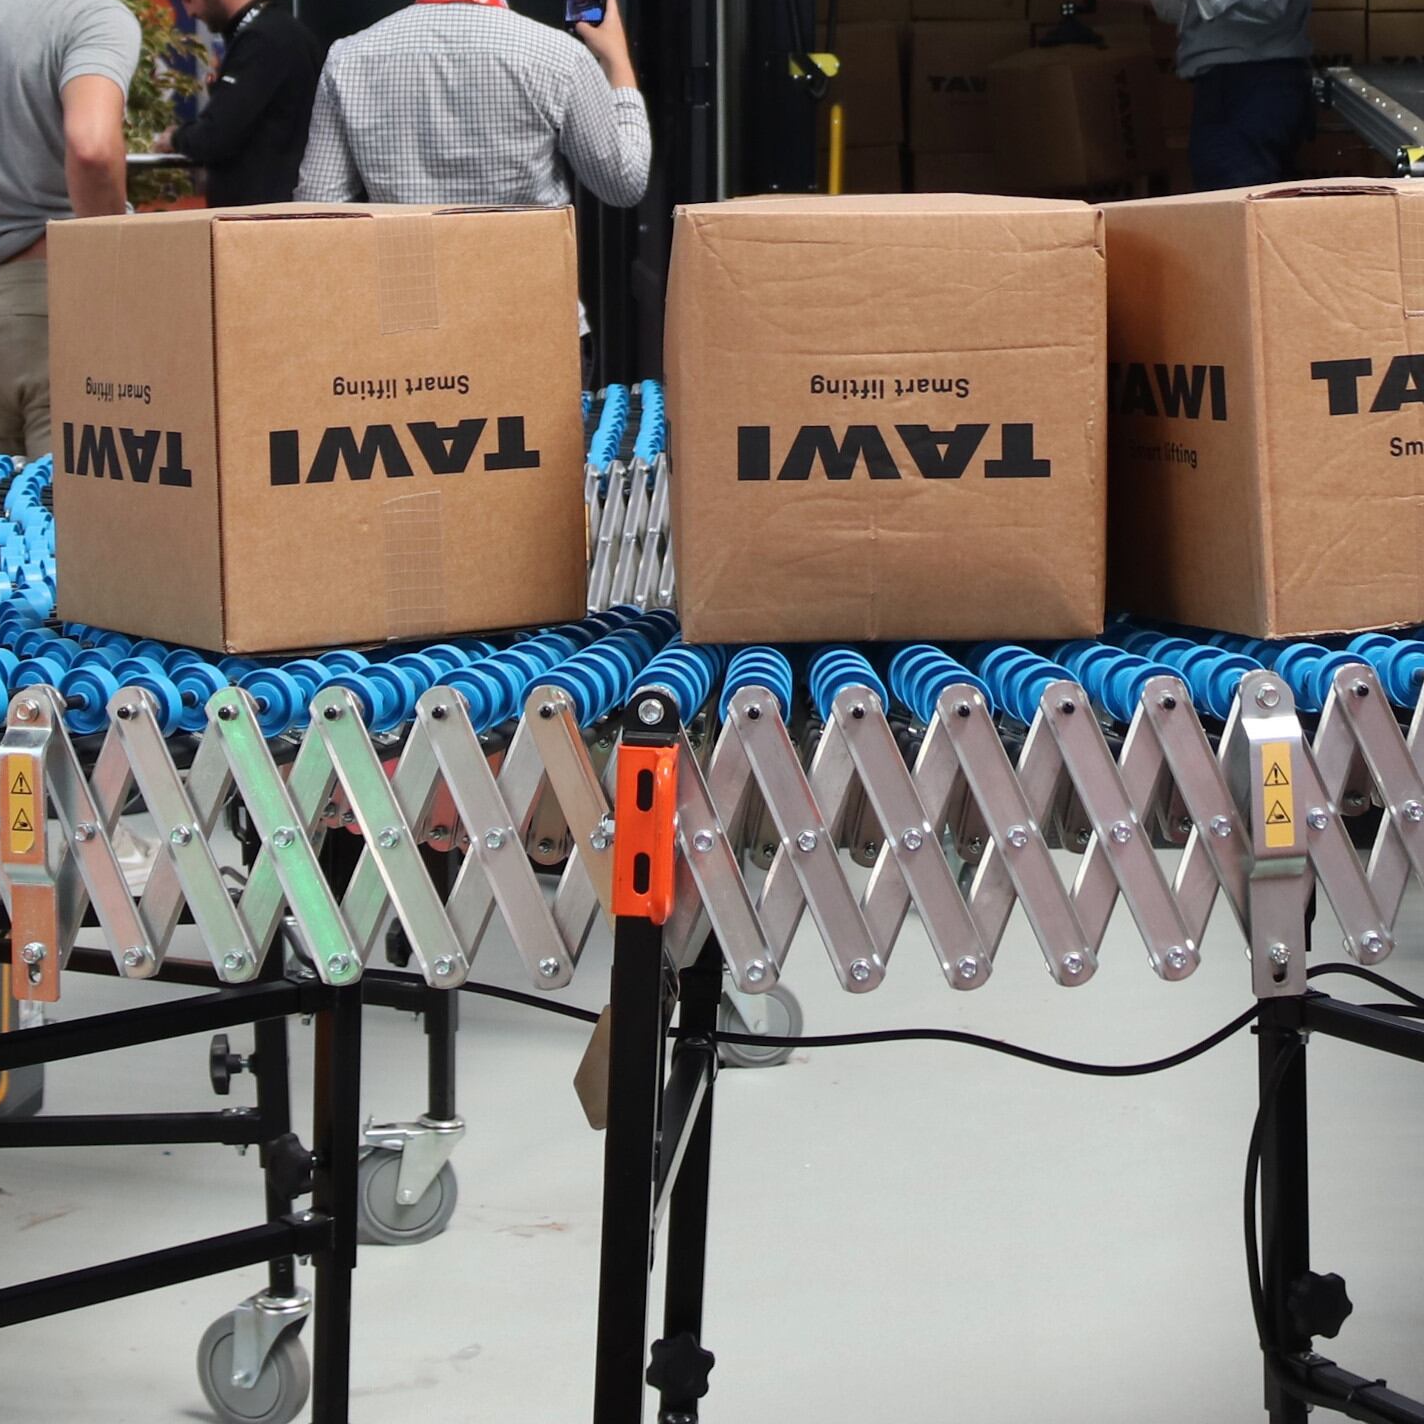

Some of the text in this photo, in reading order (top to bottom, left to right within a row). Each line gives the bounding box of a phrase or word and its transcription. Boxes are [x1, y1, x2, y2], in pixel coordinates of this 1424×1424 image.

[86, 376, 152, 405] Smart lifting
[333, 376, 470, 398] Smart lifting
[810, 375, 970, 400] Smart lifting
[63, 422, 192, 488] TAWI
[269, 416, 540, 486] TAWI
[737, 423, 1051, 481] TAWI
[1165, 442, 1199, 470] lifting
